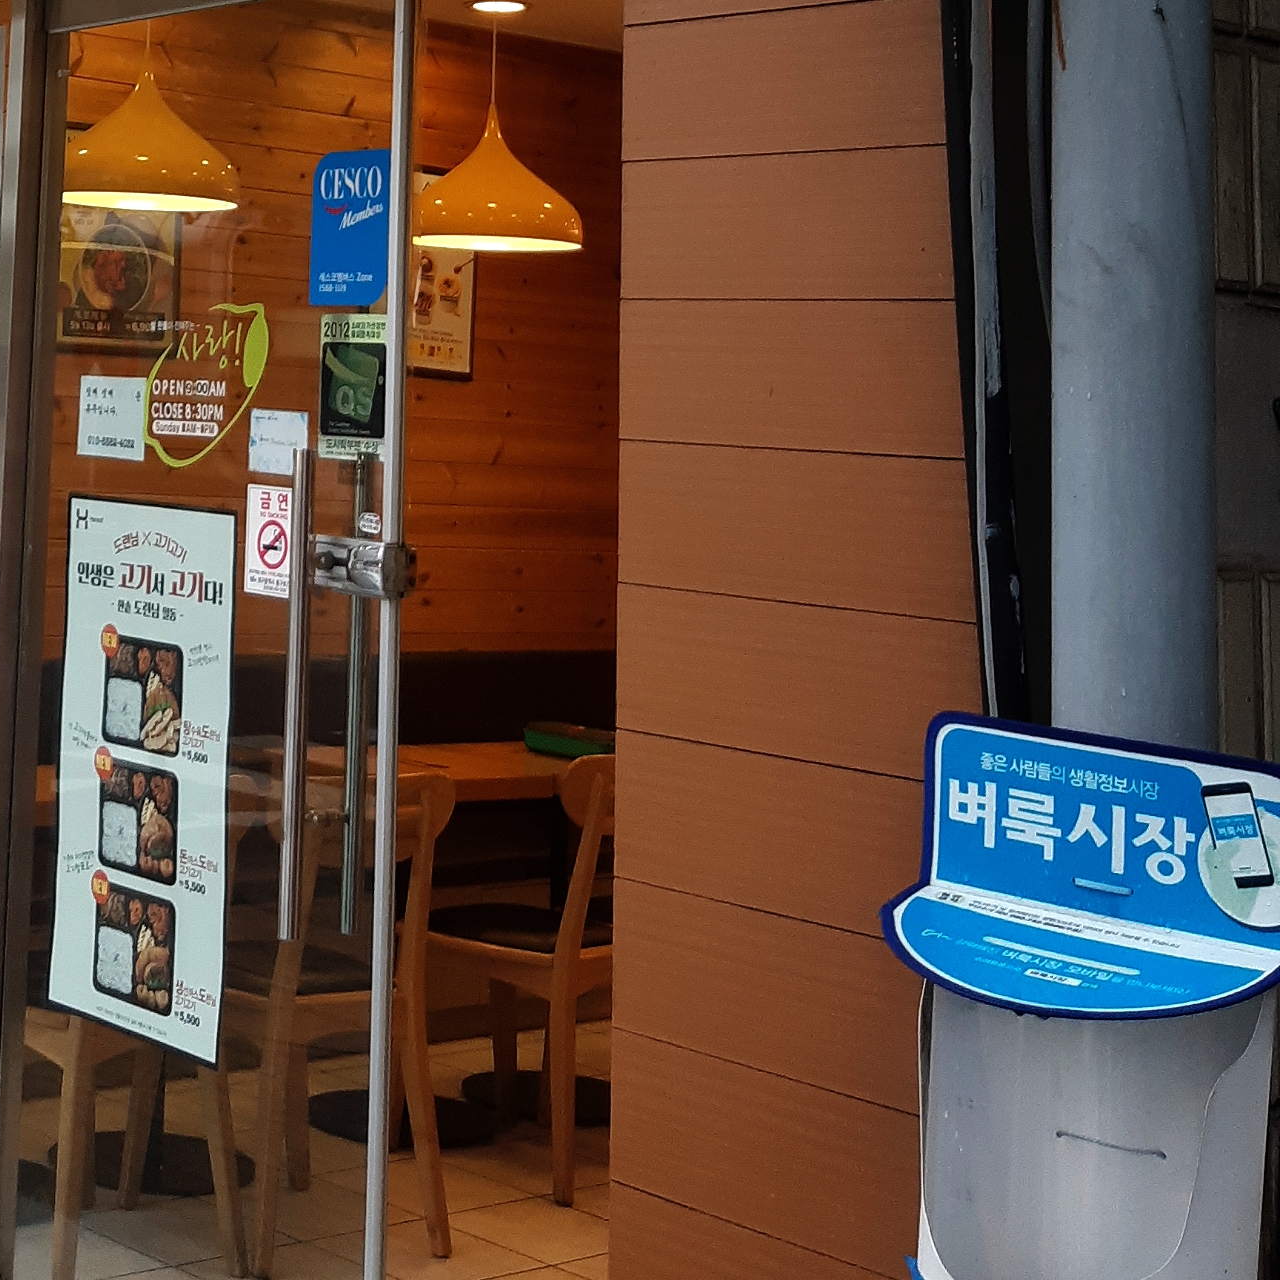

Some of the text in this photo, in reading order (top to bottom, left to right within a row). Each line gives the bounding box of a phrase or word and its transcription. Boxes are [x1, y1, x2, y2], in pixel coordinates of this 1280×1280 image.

[320, 165, 383, 201] CESCO
[338, 200, 384, 231] Members
[176, 319, 243, 370] 사랑!
[323, 321, 351, 339] 2012
[152, 379, 184, 396] OPEN
[151, 402, 224, 421] CLOSE 8:30PM
[155, 421, 180, 434] Sunday
[113, 531, 140, 554] 도련님
[154, 531, 188, 564] 고기고기
[77, 561, 224, 607] 인생은 고기서 고기다!
[133, 600, 161, 619] 도련님
[979, 751, 1160, 800] 좋은 사람들의 생활정보시장
[948, 777, 1196, 886] 벼룩시장
